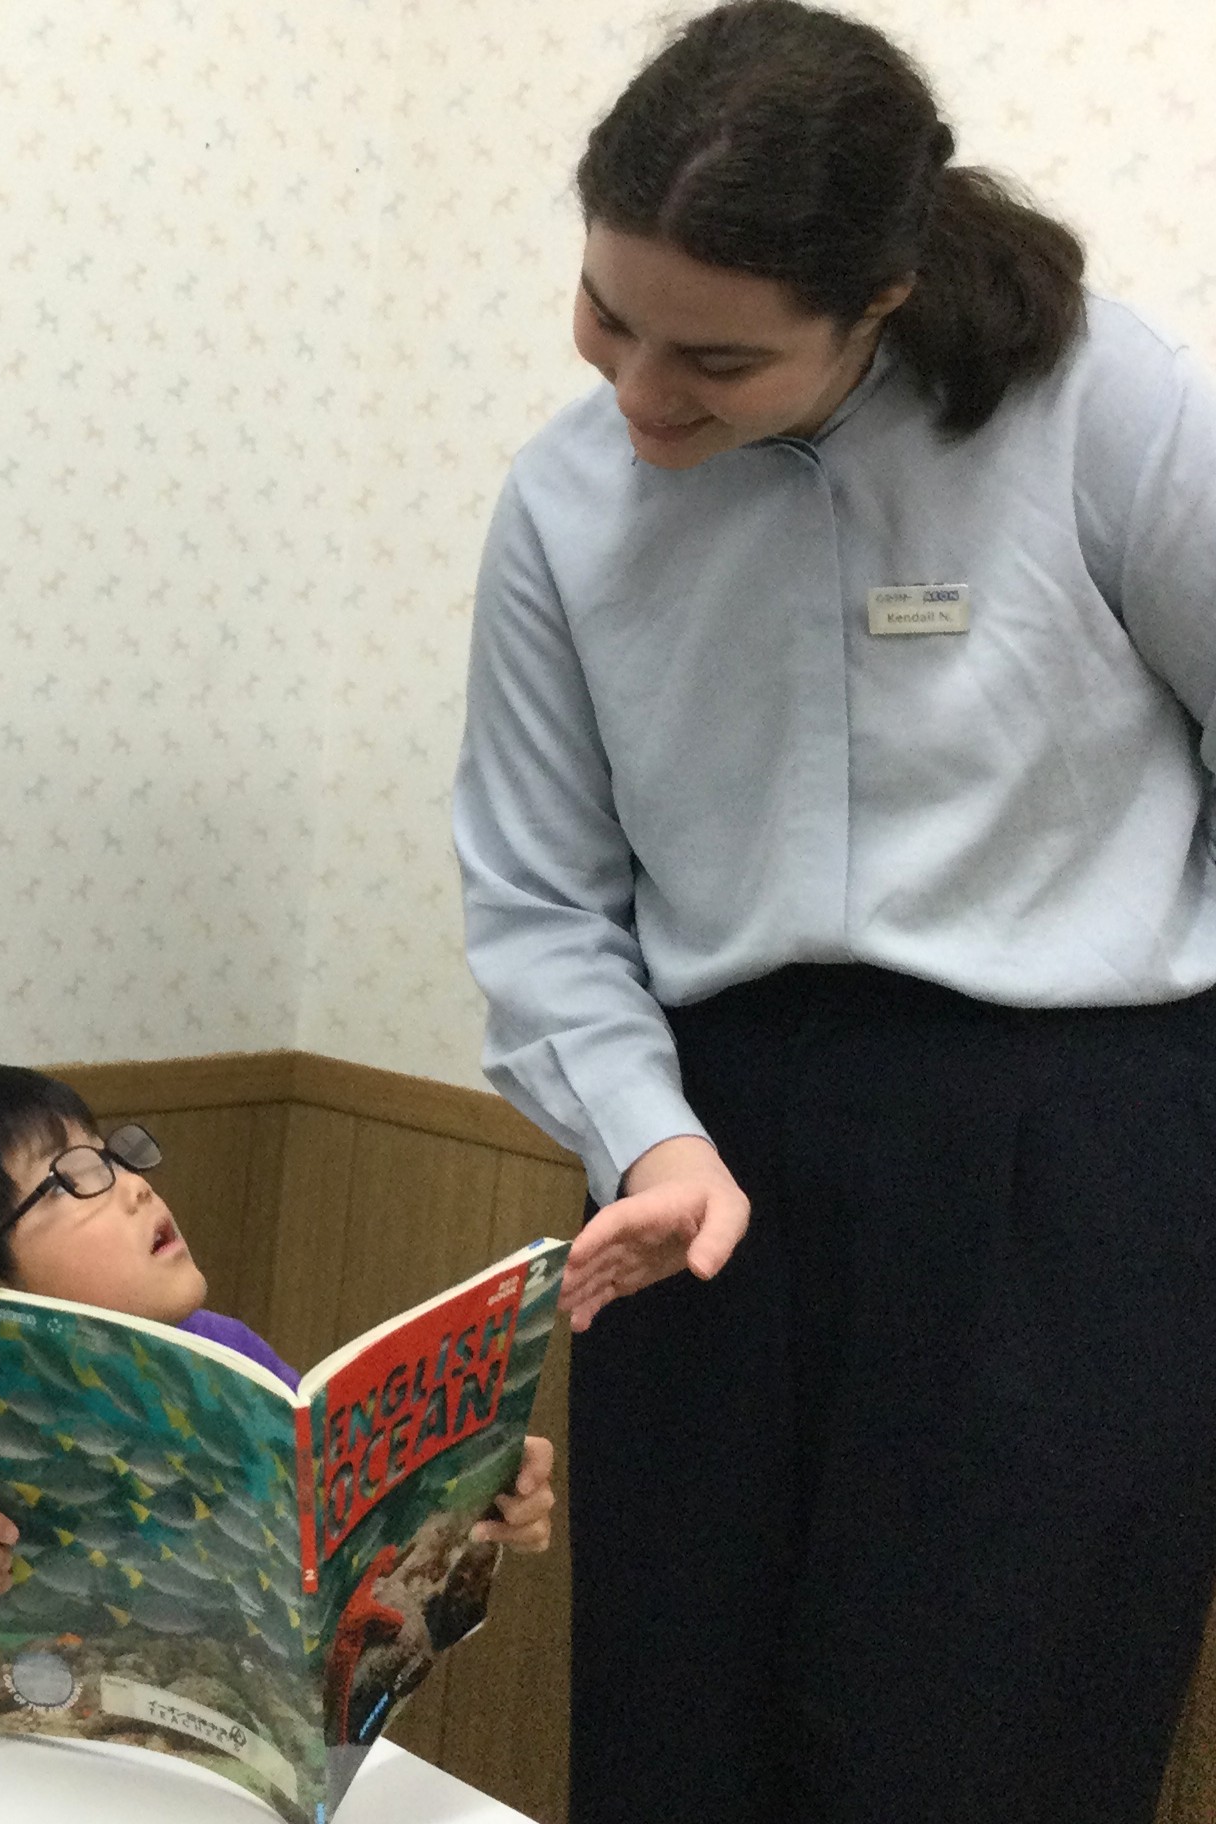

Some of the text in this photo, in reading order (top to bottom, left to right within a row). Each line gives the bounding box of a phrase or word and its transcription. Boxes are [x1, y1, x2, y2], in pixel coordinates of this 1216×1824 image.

[887, 611, 935, 623] Kendall
[524, 1257, 548, 1292] 2
[329, 1304, 514, 1464] ENGLISH
[326, 1358, 502, 1541] OCEAN
[304, 1567, 316, 1582] 2
